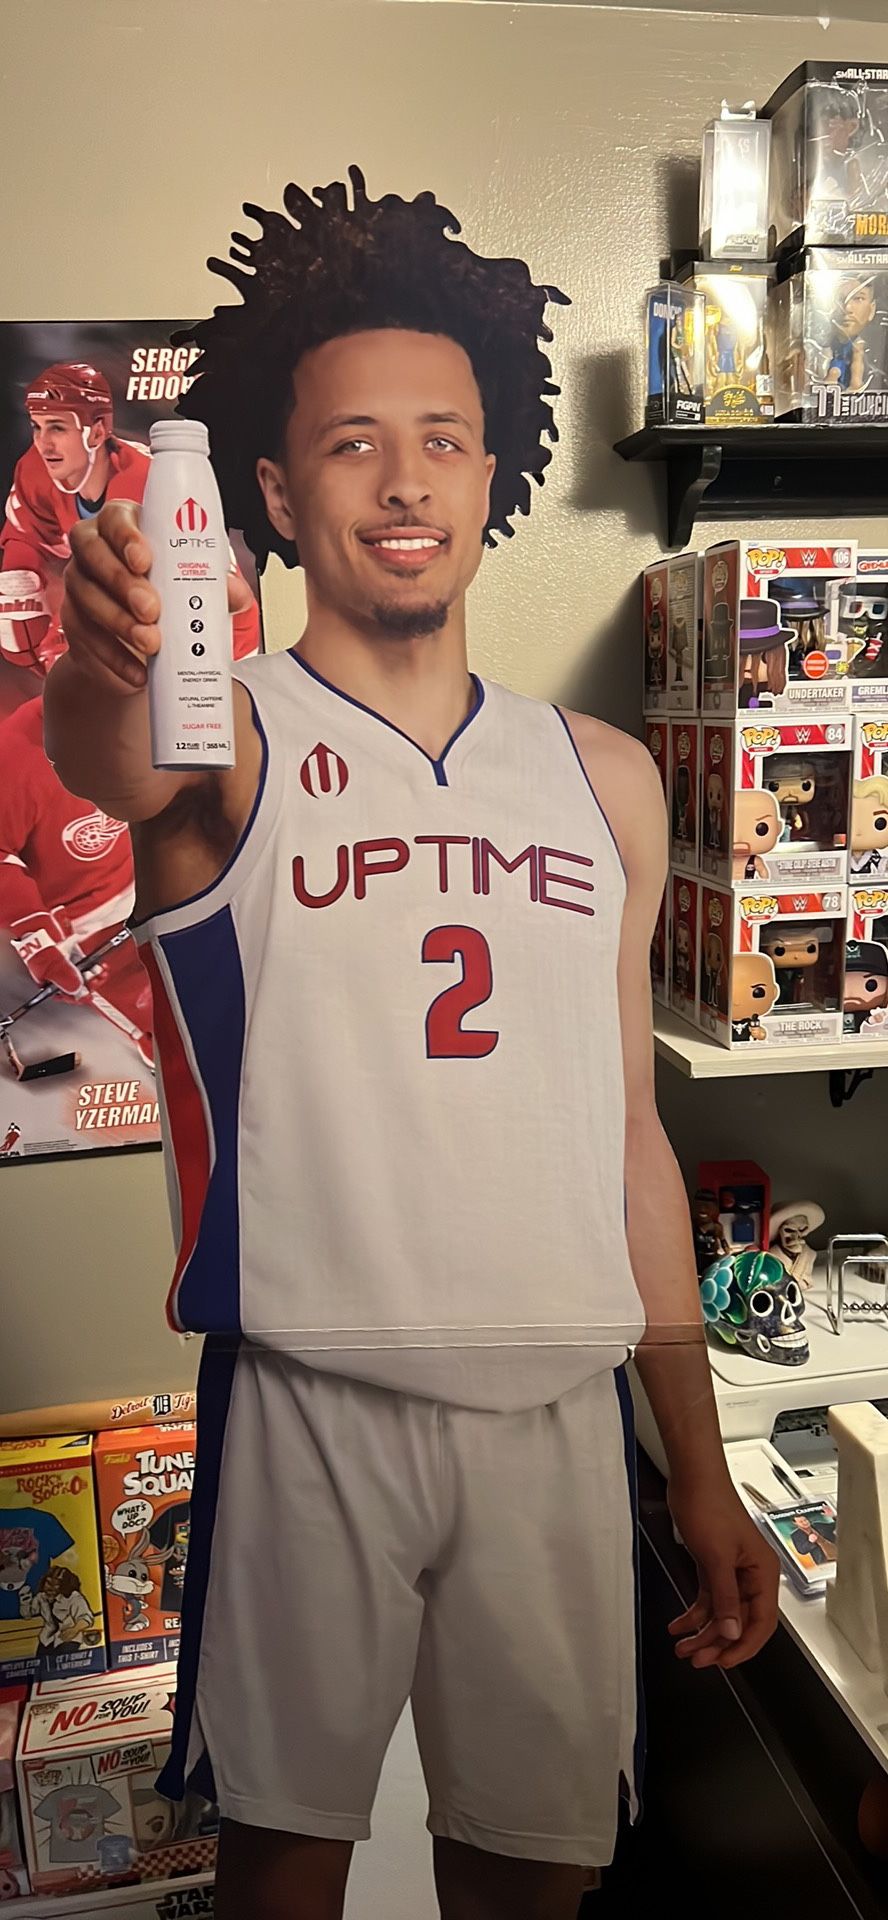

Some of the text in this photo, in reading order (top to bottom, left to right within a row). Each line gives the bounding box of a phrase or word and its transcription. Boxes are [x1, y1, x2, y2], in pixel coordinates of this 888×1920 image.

[131, 348, 205, 373] SERGE
[812, 385, 841, 417] 77
[850, 394, 888, 416] DONCI
[746, 549, 785, 569] POP!
[834, 550, 850, 565] 106
[788, 687, 845, 699] UNDERTAKER
[858, 686, 888, 695] GREML
[741, 727, 780, 747] POP!
[827, 728, 843, 741] 84
[176, 742, 187, 750] 12
[291, 834, 595, 917] UPTIME
[740, 896, 778, 916] POP!
[824, 896, 839, 908] 78
[420, 924, 499, 1060] 2
[780, 1020, 822, 1032] THE ROCK
[78, 1080, 141, 1107] STEVE
[110, 1397, 149, 1420] Detroit
[135, 1449, 196, 1475] TUNE
[123, 1469, 195, 1496] SQUA
[117, 1502, 147, 1516] WHAT'S
[127, 1512, 139, 1521] UP
[122, 1518, 147, 1529] DOC?
[121, 1642, 153, 1654] INCLUDES
[118, 1654, 133, 1664] THIS
[48, 1701, 98, 1735] NO
[98, 1692, 147, 1712] SOUP
[94, 1699, 151, 1721] FOR YOU!
[97, 1744, 149, 1774] NO SOUP
